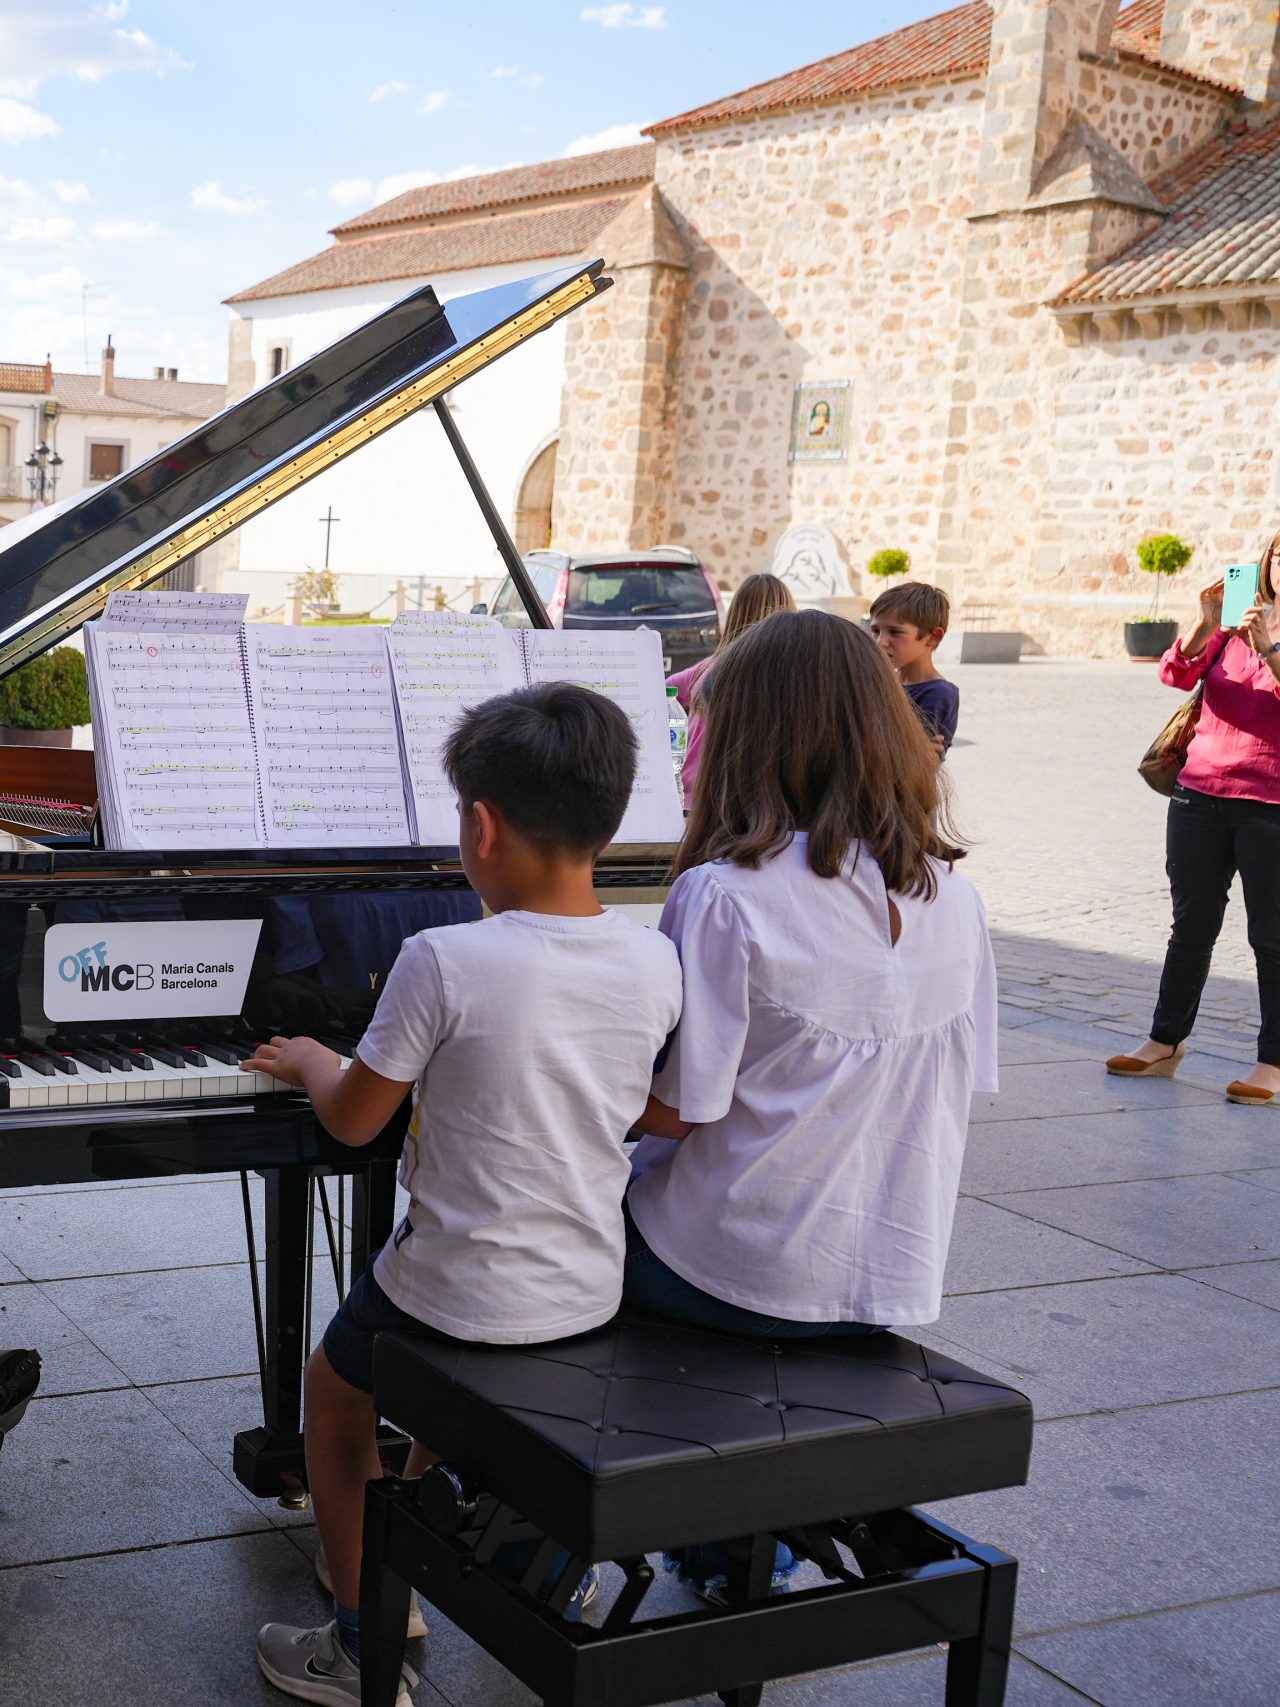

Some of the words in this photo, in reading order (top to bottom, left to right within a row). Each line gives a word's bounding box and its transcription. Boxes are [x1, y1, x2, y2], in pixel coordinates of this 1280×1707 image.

[58, 941, 107, 983] OFF
[81, 964, 154, 992] MCB
[161, 963, 194, 975] Maria
[196, 962, 234, 973] Canals
[161, 978, 218, 990] Barcelona
